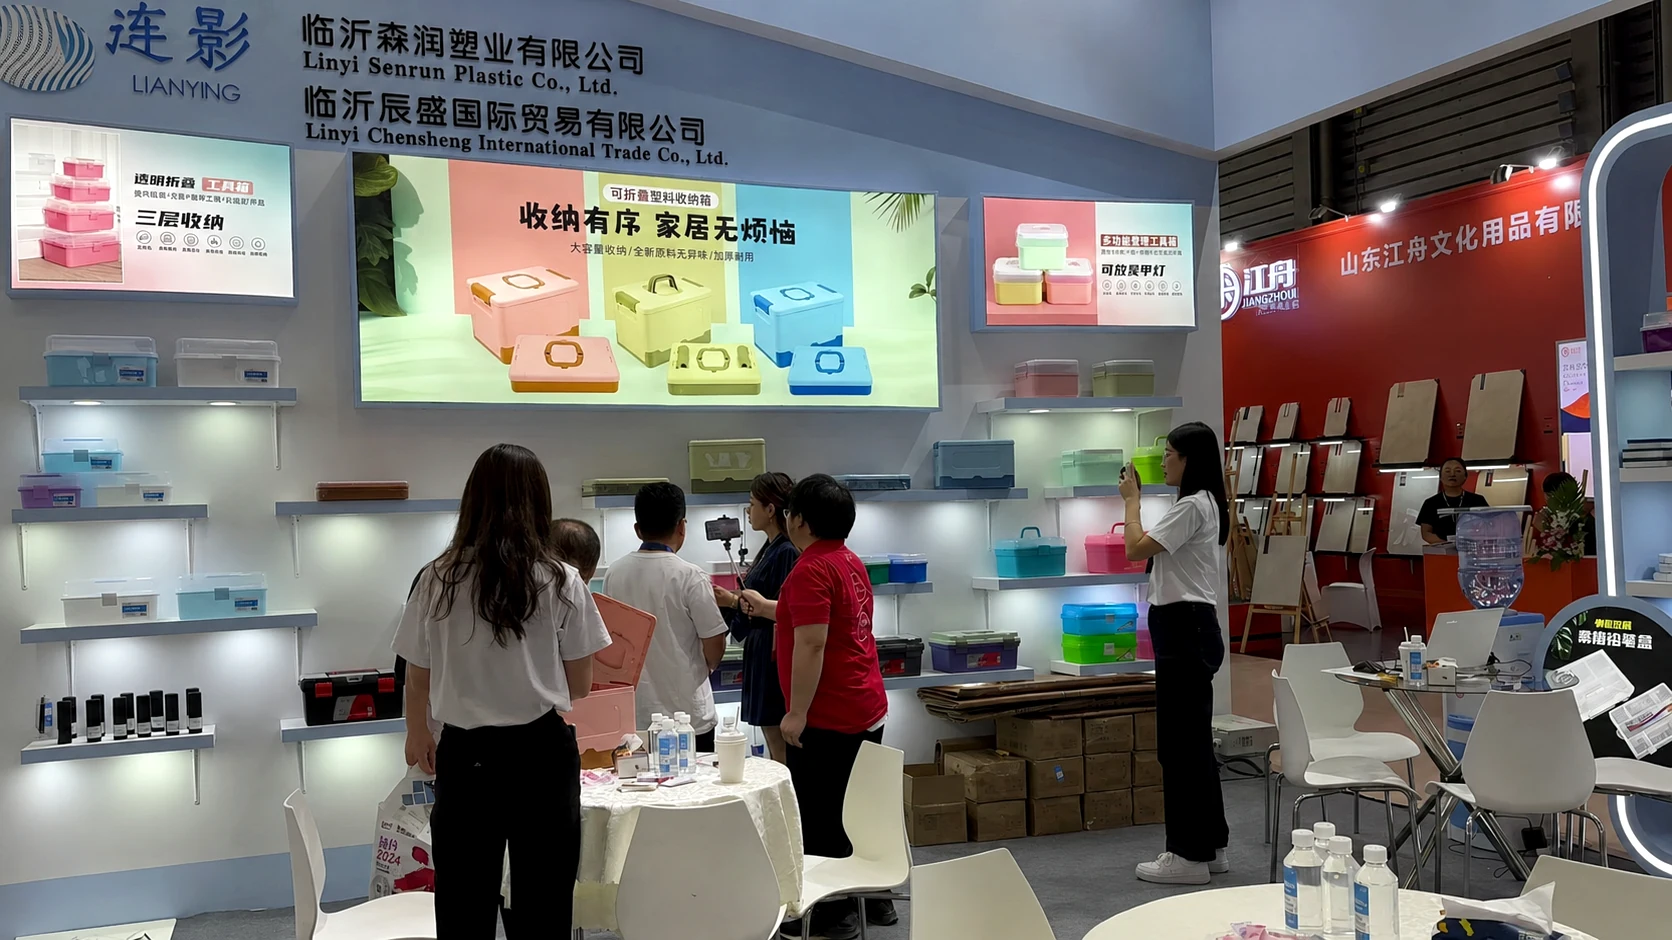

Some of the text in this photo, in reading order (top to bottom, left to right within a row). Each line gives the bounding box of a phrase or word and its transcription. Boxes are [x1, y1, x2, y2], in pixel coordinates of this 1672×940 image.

[105, 1, 250, 71] 连影
[302, 13, 644, 75] 临沂森润塑业有限公司
[132, 75, 241, 101] LIANYING
[303, 51, 618, 95] Linyi Senrun Plastic Co., Ltd.
[304, 85, 705, 146] 临沂辰盛国际贸易有限公司
[305, 123, 729, 166] Linyi Chensheng International Trade Co., Ltd.
[135, 209, 225, 231] 三层收纳
[520, 201, 796, 245] 收纳有序 家居无烦恼
[1242, 288, 1297, 309] JIANGZHOU
[1243, 259, 1296, 296] 江舟
[376, 849, 401, 866] 2024
